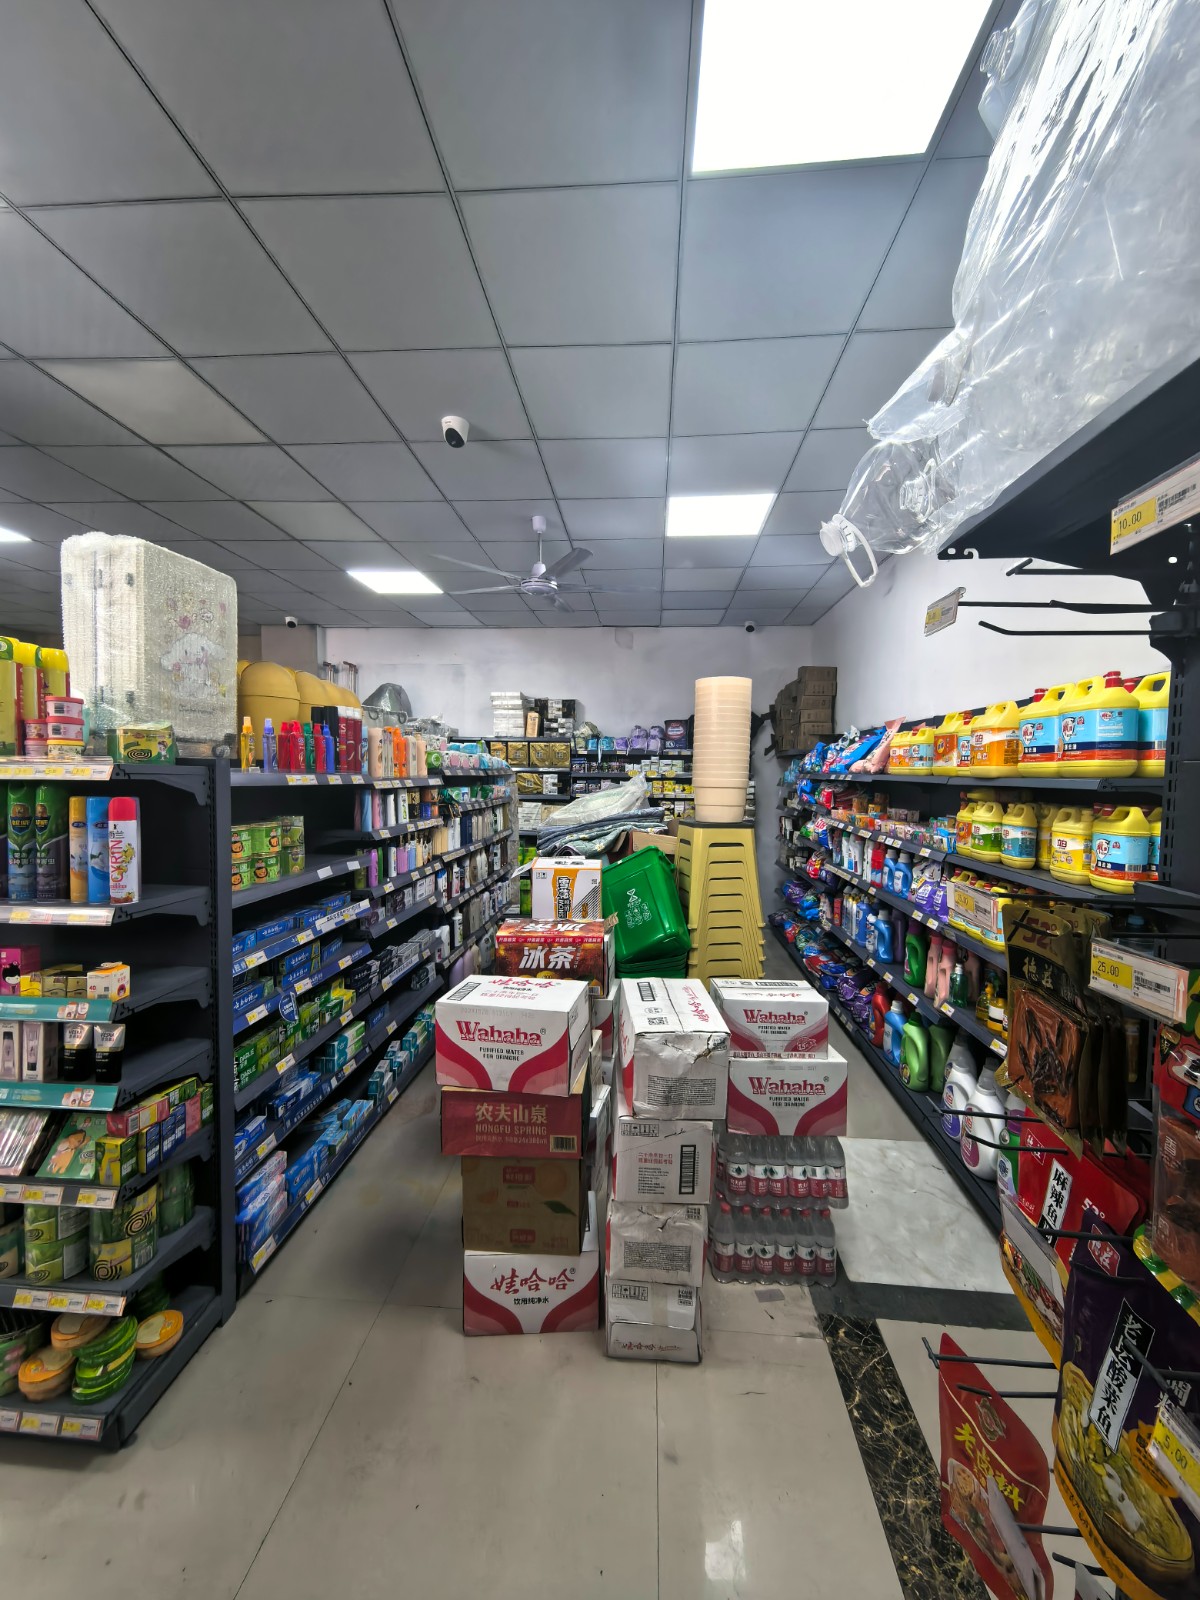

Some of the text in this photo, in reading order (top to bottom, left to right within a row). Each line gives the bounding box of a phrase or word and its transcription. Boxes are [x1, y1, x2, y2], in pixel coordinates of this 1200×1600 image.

[1119, 511, 1142, 530] 10.00
[518, 945, 577, 970] 冰茶
[1097, 961, 1120, 978] 25.00
[743, 1008, 806, 1025] Wahaha
[455, 1020, 543, 1047] Wahaha
[748, 1076, 826, 1096] Wahaha
[475, 1102, 548, 1124] 农夫山泉
[475, 1124, 547, 1136] NONGFU SPRING
[1047, 1167, 1069, 1226] 麻辣鱼
[489, 1267, 575, 1295] 娃哈哈
